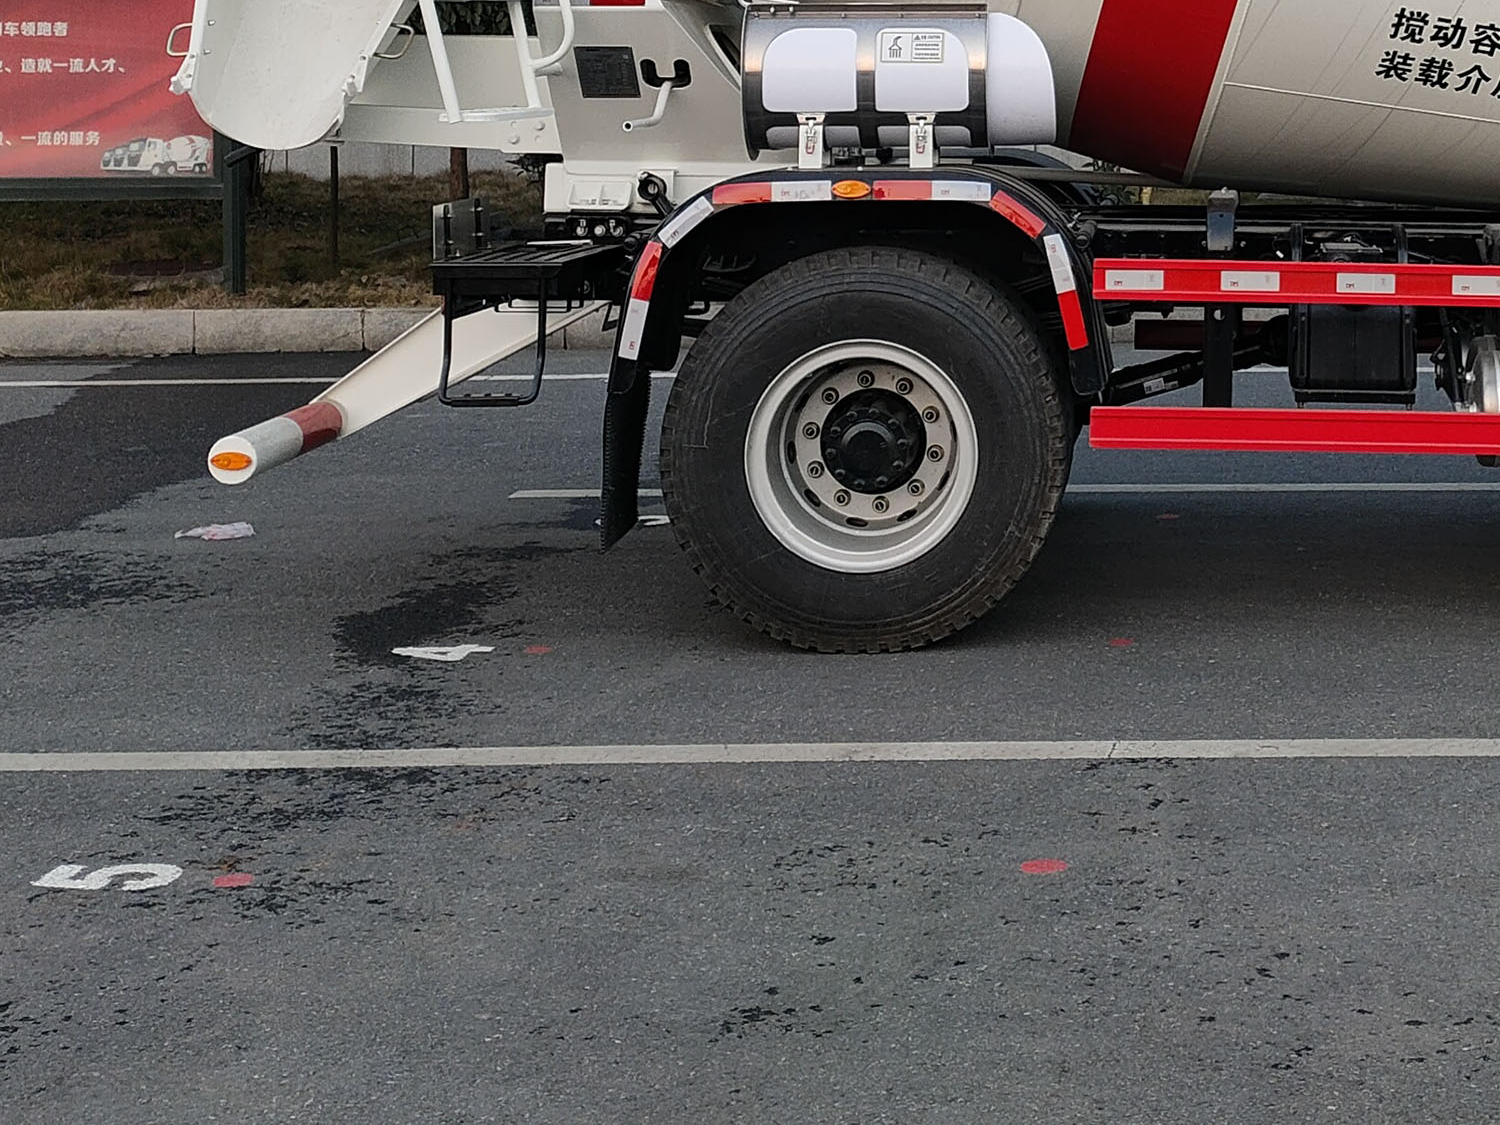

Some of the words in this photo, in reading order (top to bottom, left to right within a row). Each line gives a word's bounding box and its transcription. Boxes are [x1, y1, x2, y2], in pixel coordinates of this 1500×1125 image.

[0, 21, 69, 38] 车领跑者
[0, 58, 126, 74] 、造就一流人才、
[0, 131, 101, 147] 、一流的服务
[30, 863, 184, 891] 5
